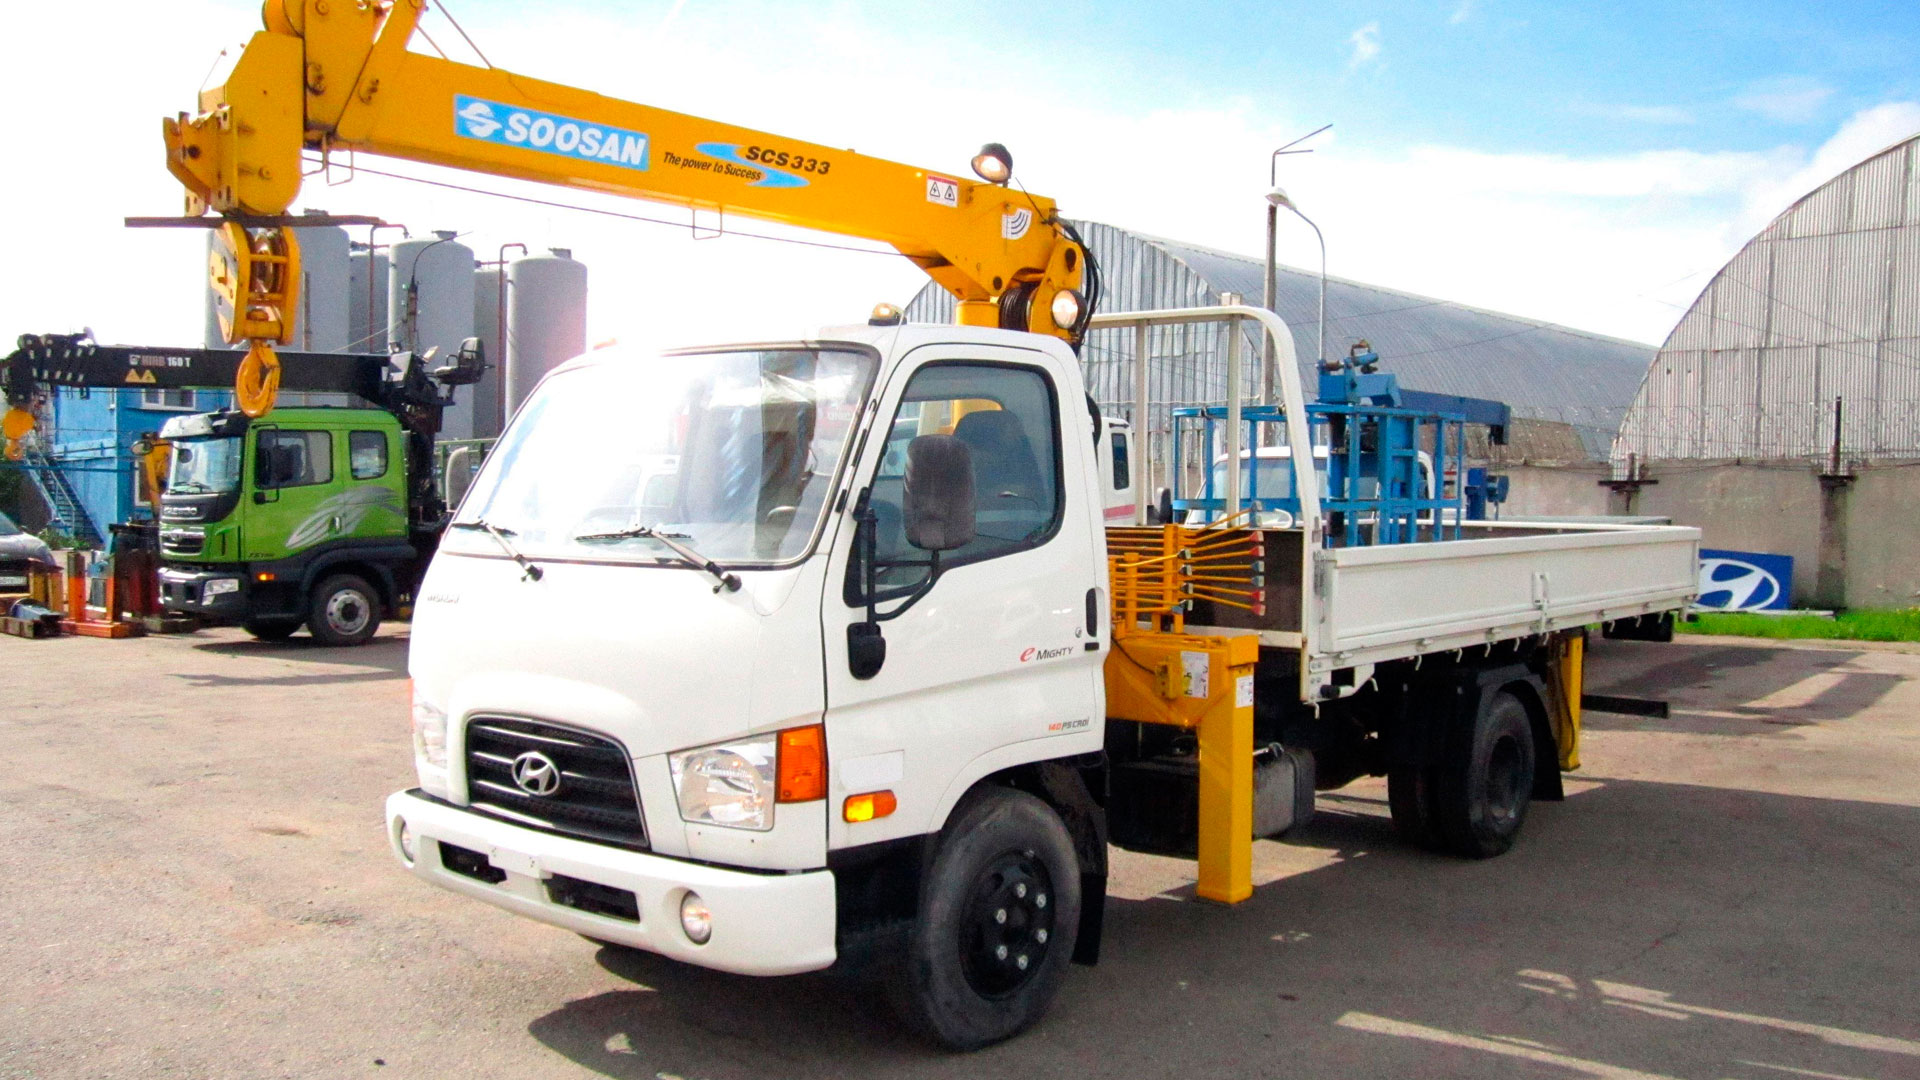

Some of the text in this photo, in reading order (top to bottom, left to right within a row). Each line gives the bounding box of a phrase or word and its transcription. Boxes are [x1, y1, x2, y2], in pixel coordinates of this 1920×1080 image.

[504, 112, 647, 165] SOOSAN
[663, 151, 762, 181] The power to Success
[167, 356, 184, 367] 160
[1020, 647, 1036, 662] e
